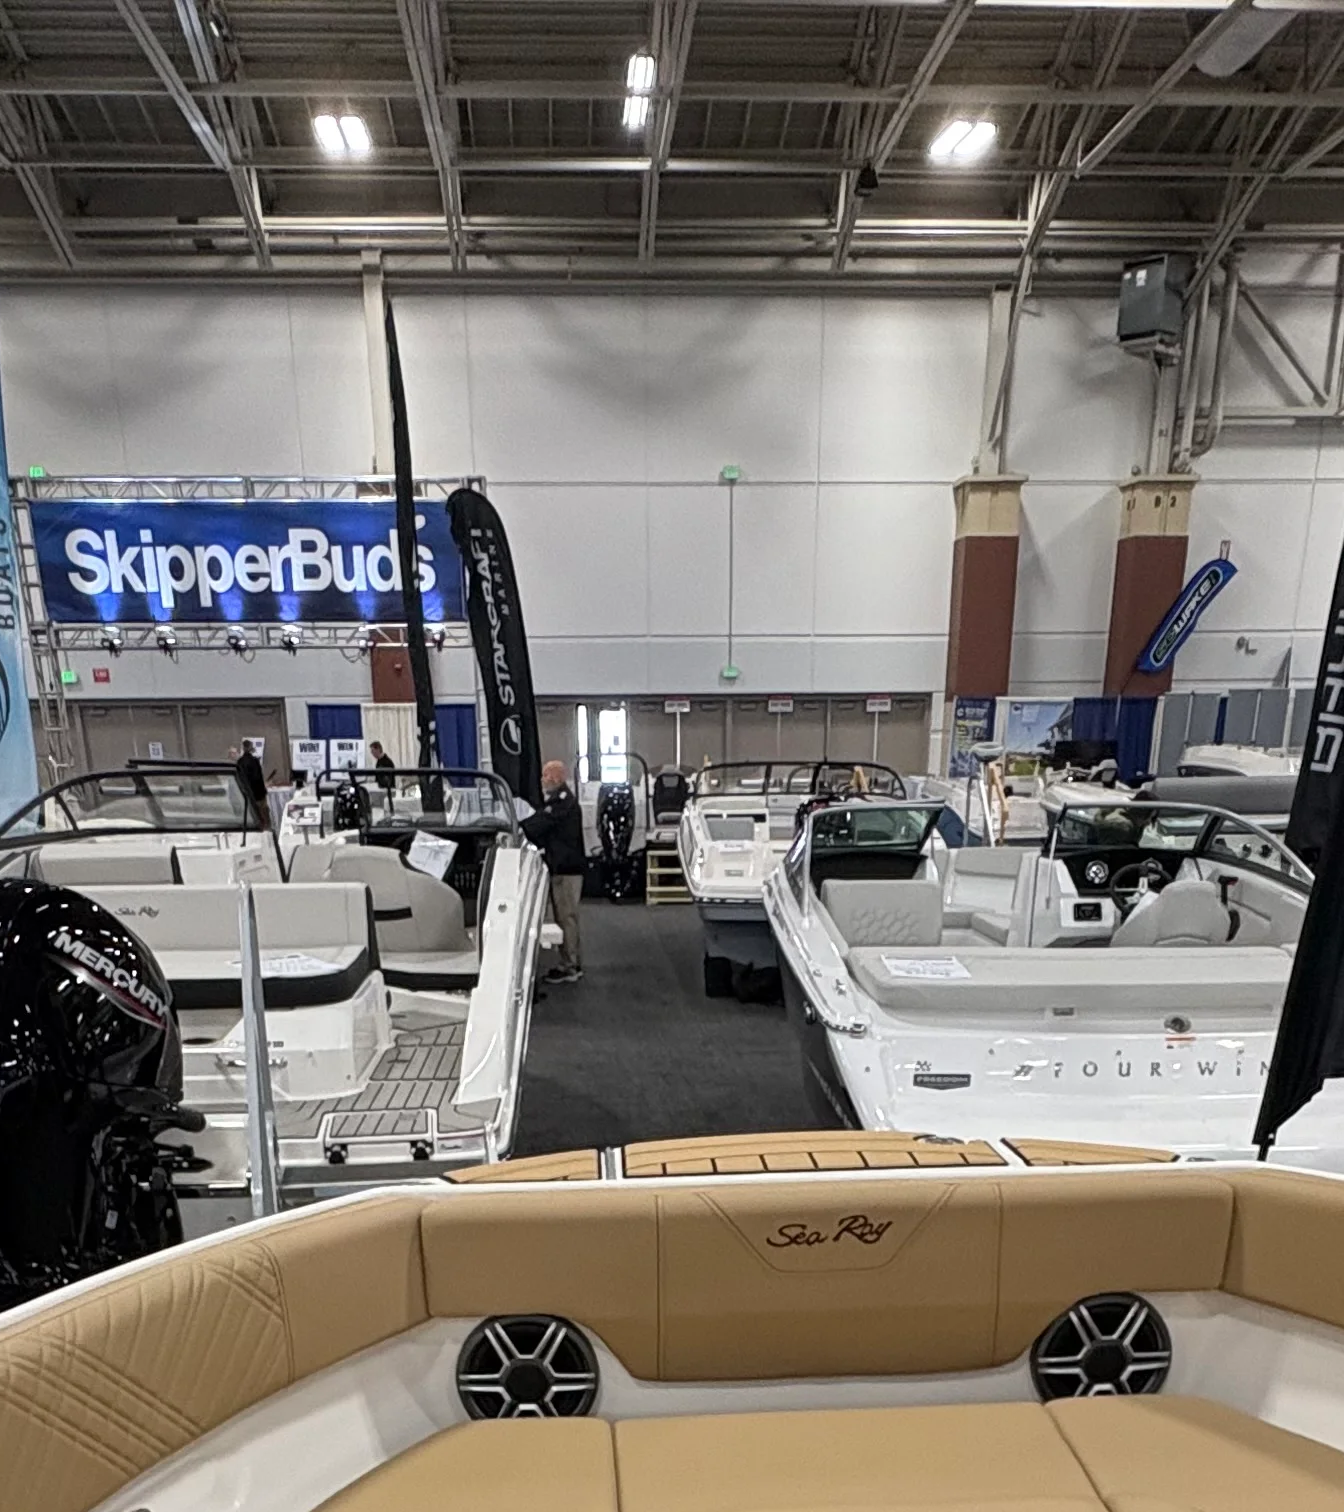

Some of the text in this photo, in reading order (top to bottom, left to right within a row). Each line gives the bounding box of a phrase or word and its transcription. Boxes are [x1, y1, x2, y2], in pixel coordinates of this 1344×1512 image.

[54, 932, 169, 1017] MERCURY
[1053, 1061, 1163, 1078] FOUR
[766, 1214, 894, 1248] Sea Ray
